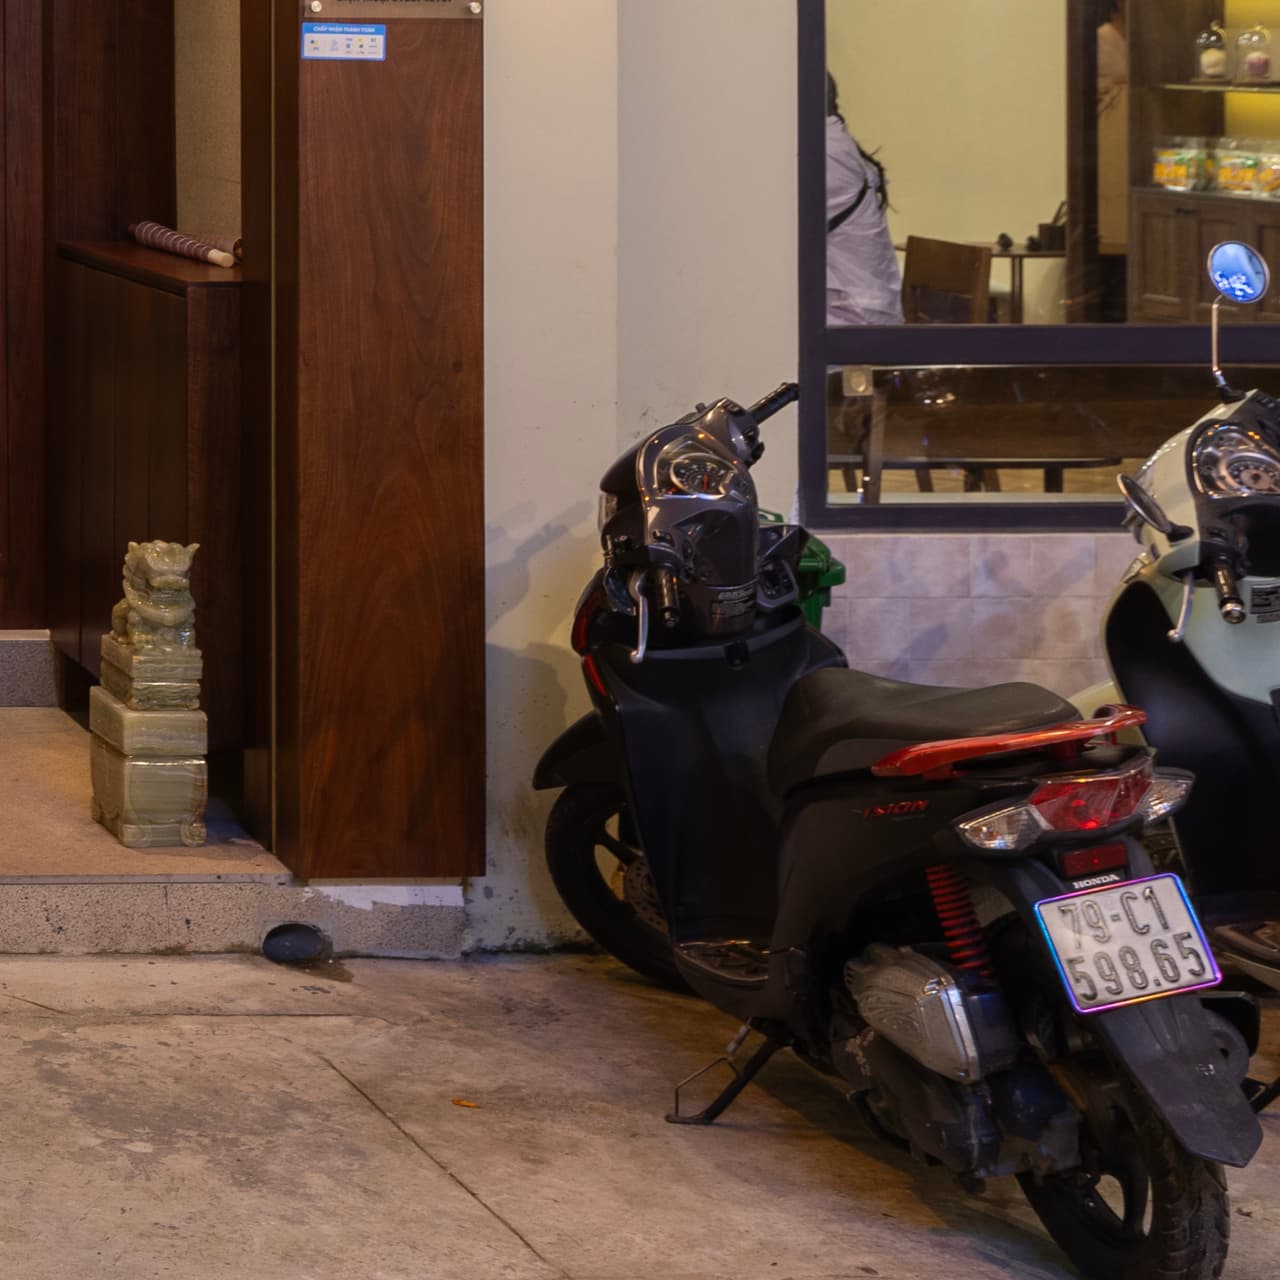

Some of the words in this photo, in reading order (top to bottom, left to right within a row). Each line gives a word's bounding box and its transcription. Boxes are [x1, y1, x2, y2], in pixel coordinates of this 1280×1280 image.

[1073, 873, 1121, 889] HONDA
[1058, 886, 1170, 950] 79-C1
[1064, 931, 1207, 1003] 598.65
